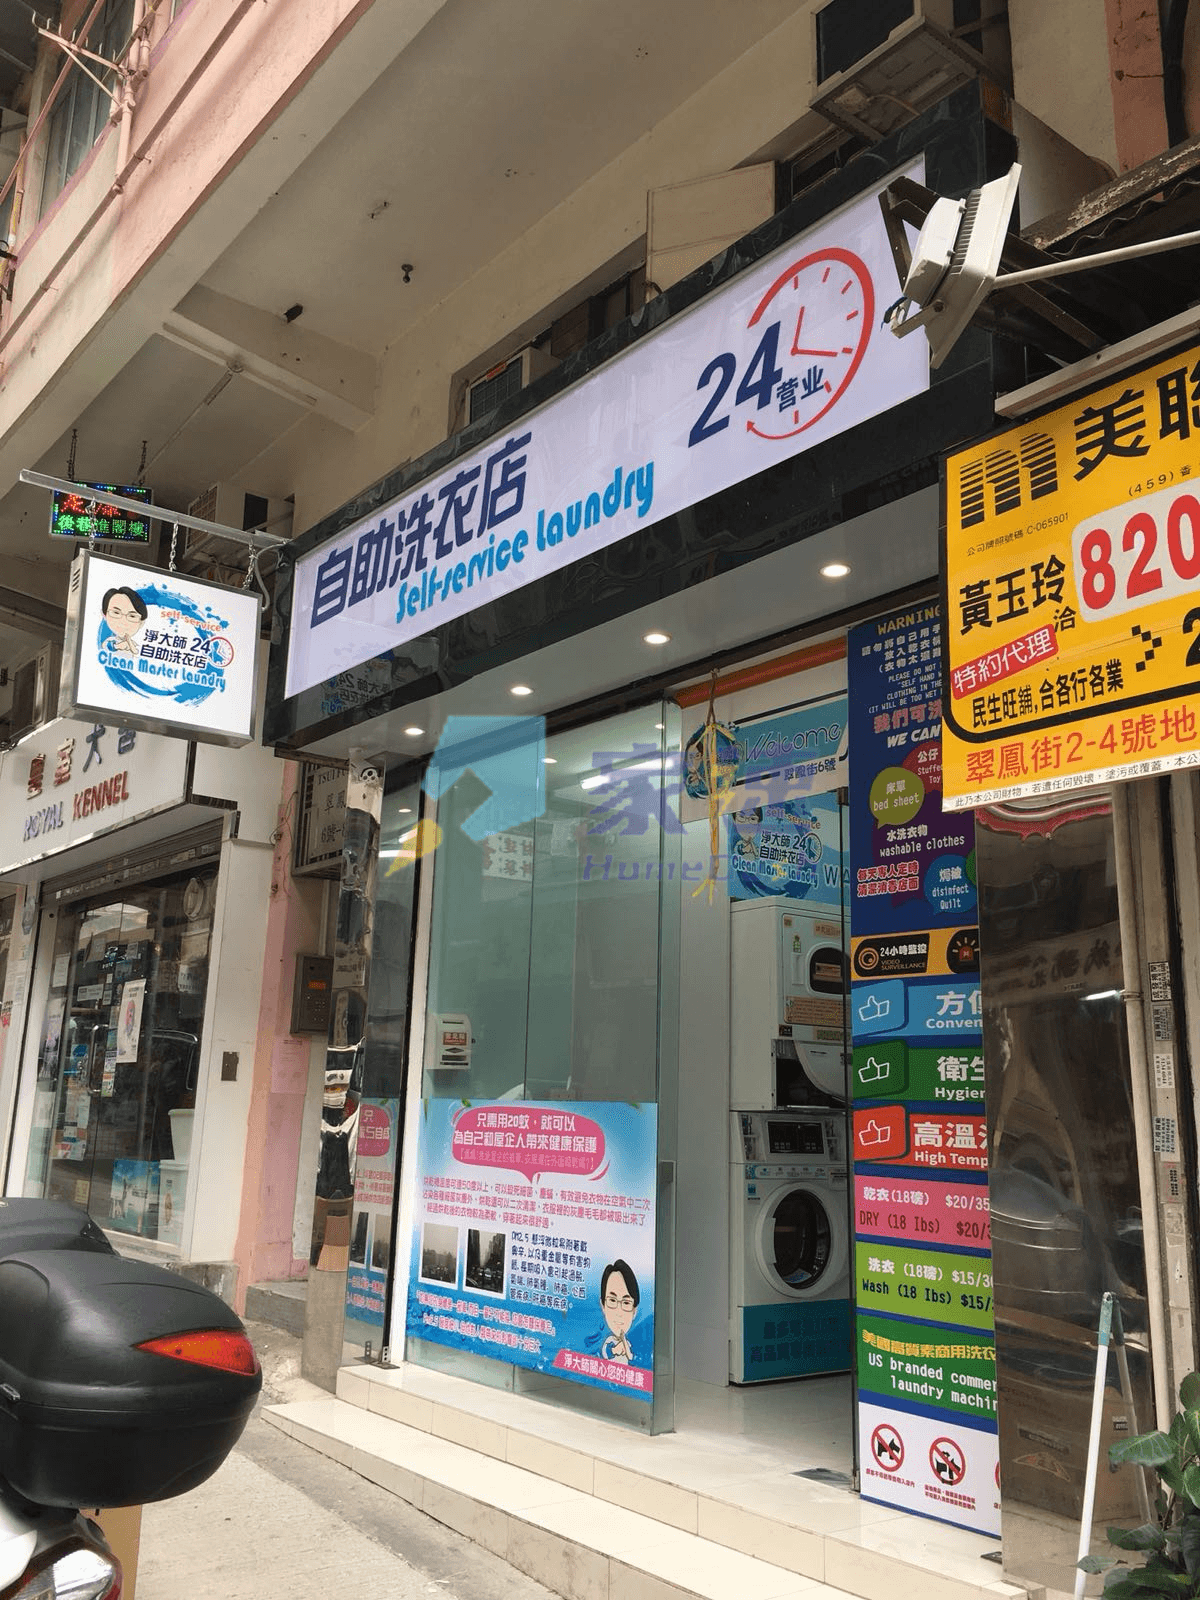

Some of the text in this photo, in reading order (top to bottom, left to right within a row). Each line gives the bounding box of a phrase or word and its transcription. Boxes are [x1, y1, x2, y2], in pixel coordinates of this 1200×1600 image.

[688, 320, 824, 448] 24 营业
[311, 431, 532, 629] 自助洗衣店
[1026, 512, 1070, 537] C-065901
[1081, 495, 1200, 610] 820
[396, 528, 529, 624] Self-service
[960, 554, 1066, 635] 黃玉玲
[160, 610, 222, 632] self-service
[1053, 606, 1077, 633] 洽
[143, 629, 211, 654] 淨大師 24
[98, 650, 134, 670] Clean
[138, 658, 178, 680] Master
[140, 644, 208, 669] 自助洗衣店
[953, 629, 1054, 692] 特約代理
[888, 663, 936, 683] PLEASE DO NOT
[919, 672, 935, 683] HAND
[886, 679, 942, 700] CLOTHING IN THE
[972, 659, 1124, 730] 民生旺舖,合各行各業
[881, 701, 896, 712] WILL
[899, 697, 907, 706] BE
[911, 693, 922, 704] TOO
[925, 690, 937, 701] WET
[745, 724, 841, 764] Welcome
[887, 724, 941, 748] WE CAN
[965, 704, 1198, 784] 翠鳳街2-4號地
[917, 748, 938, 764] 公仔
[929, 774, 941, 785] Toy
[23, 771, 129, 842] ROYAL KENNEL
[873, 793, 920, 811] bed sheet
[766, 809, 822, 830] self-service
[761, 830, 807, 850] 淨大師 24
[886, 824, 928, 842] 水洗衣物
[759, 845, 805, 866] 自助洗衣店
[880, 834, 965, 858] washable clothes
[731, 854, 757, 872] Clean
[857, 860, 920, 882] 每天專人定時
[857, 877, 920, 898] 清潔消毒店面
[932, 884, 969, 898] disinfect
[940, 899, 962, 911] Quilt
[880, 943, 927, 957] 24小時監控
[881, 962, 926, 971] SURVEILLANCE
[926, 1018, 983, 1029] Conven
[914, 1149, 988, 1169] High Temp
[945, 1193, 990, 1211] $20/35
[859, 1211, 879, 1227] DRY
[888, 1213, 907, 1231] (18
[867, 1256, 895, 1276] 洗衣
[903, 1262, 943, 1282] (18磅)
[862, 1279, 889, 1297] Wash
[897, 1284, 918, 1300] (18
[960, 1292, 993, 1312] $15/
[563, 1352, 645, 1390] 淨大師關心您的健康
[868, 1351, 884, 1369] US
[890, 1358, 944, 1381] branded
[890, 1374, 944, 1400] laundry
